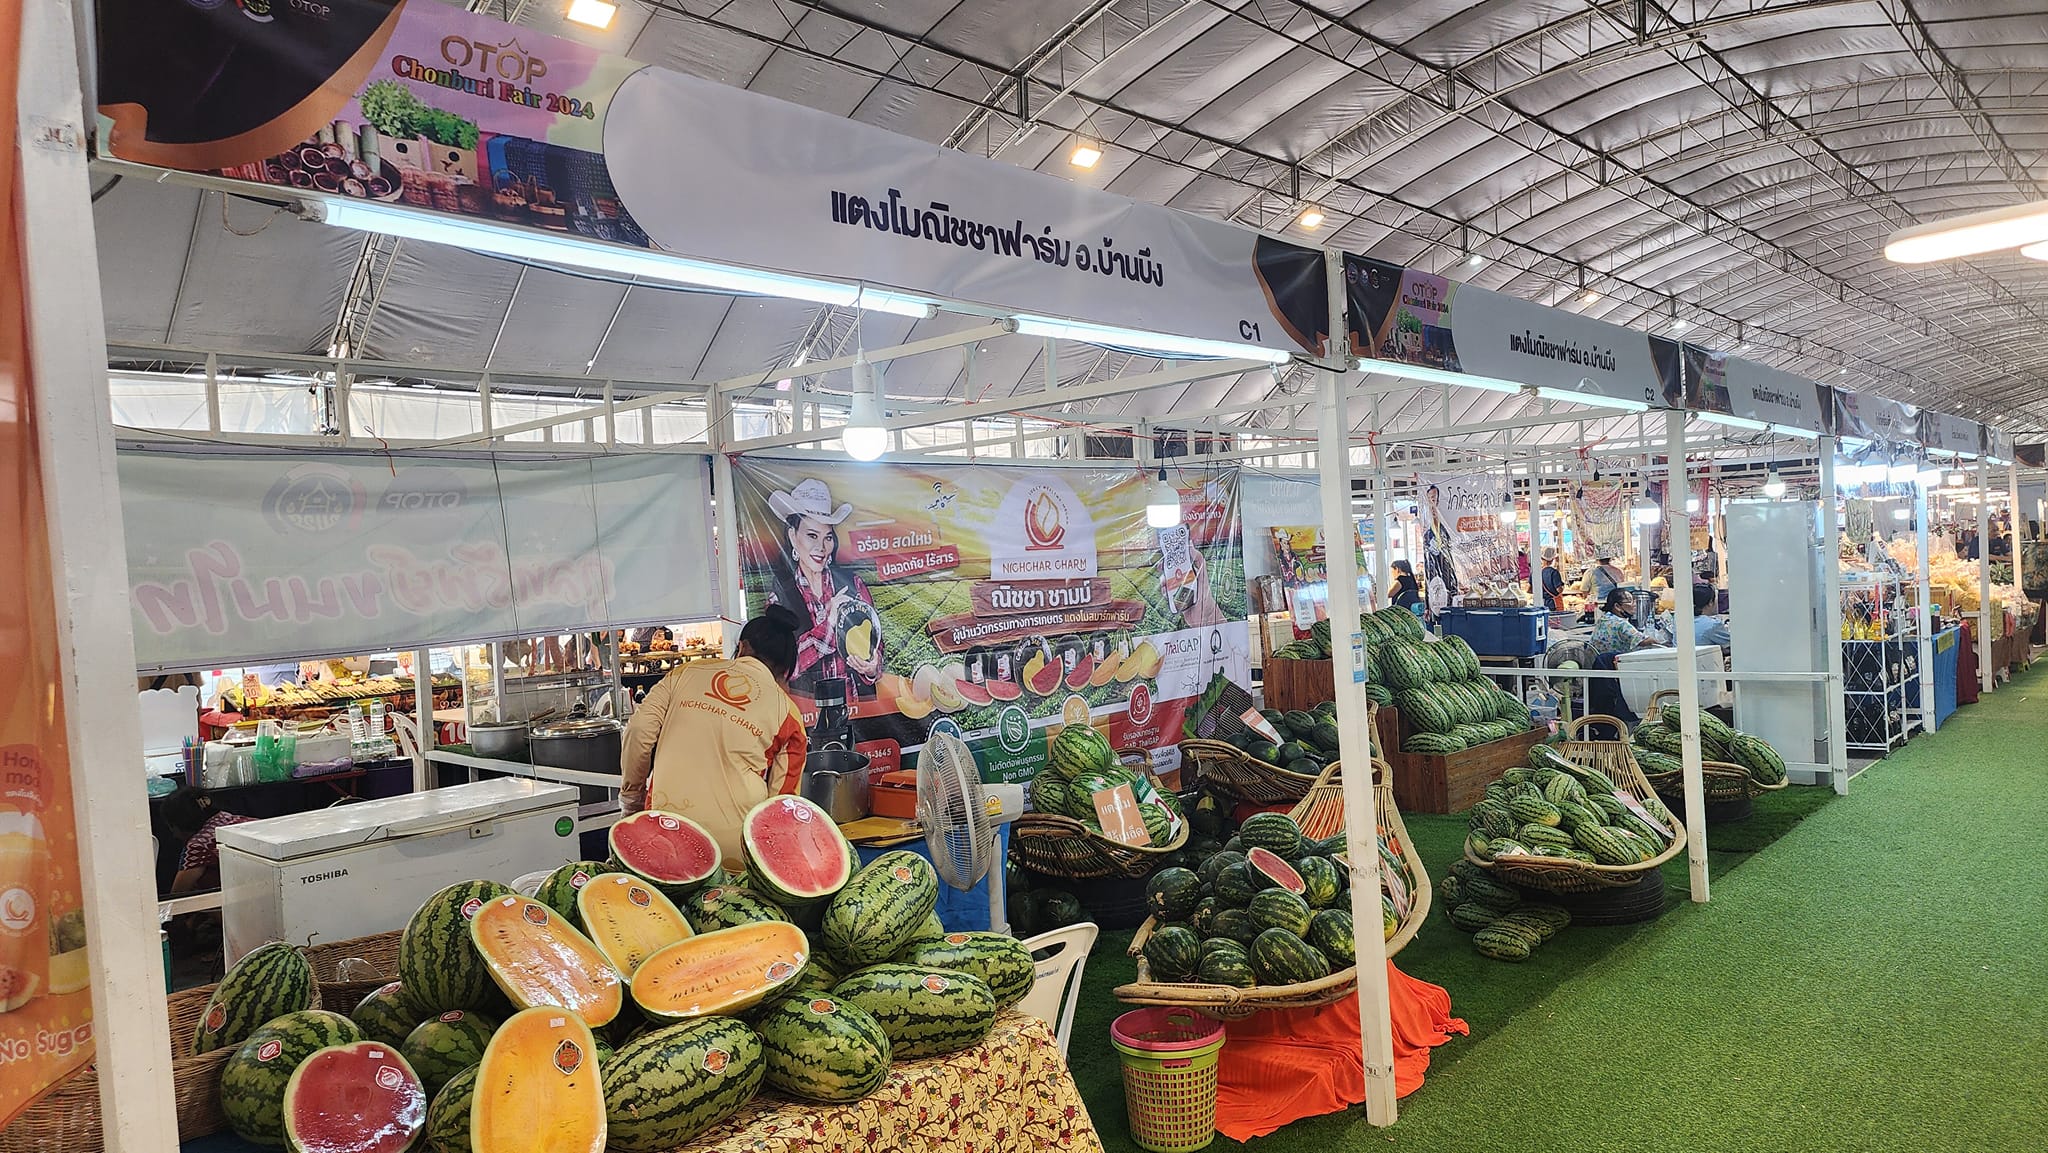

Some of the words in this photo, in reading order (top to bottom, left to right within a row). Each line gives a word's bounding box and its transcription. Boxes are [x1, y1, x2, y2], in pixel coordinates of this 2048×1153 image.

[440, 35, 547, 84] OTOP
[391, 54, 495, 99] Chonburi
[499, 80, 543, 108] Fair
[546, 92, 595, 120] 2024
[831, 187, 1070, 267] แตงโมณิชชาฟาร์ม
[1075, 236, 1164, 287] อ.บ้านบึง
[1239, 319, 1262, 342] C1
[1644, 387, 1655, 401] C2
[856, 535, 889, 552] อร่อย
[892, 530, 932, 549] สดใหม่
[882, 556, 924, 576] ปลอดภัย
[926, 552, 954, 567] ไร้สาร
[1002, 560, 1052, 574] NICHCHAR
[1054, 558, 1087, 572] CHARM
[991, 585, 1045, 609] ณิชชา
[679, 699, 728, 718] NICHCHAR
[1002, 772, 1017, 782] Non
[1017, 766, 1035, 778] GMO
[300, 868, 349, 885] TOSHIBA
[36, 1021, 96, 1056] Suga
